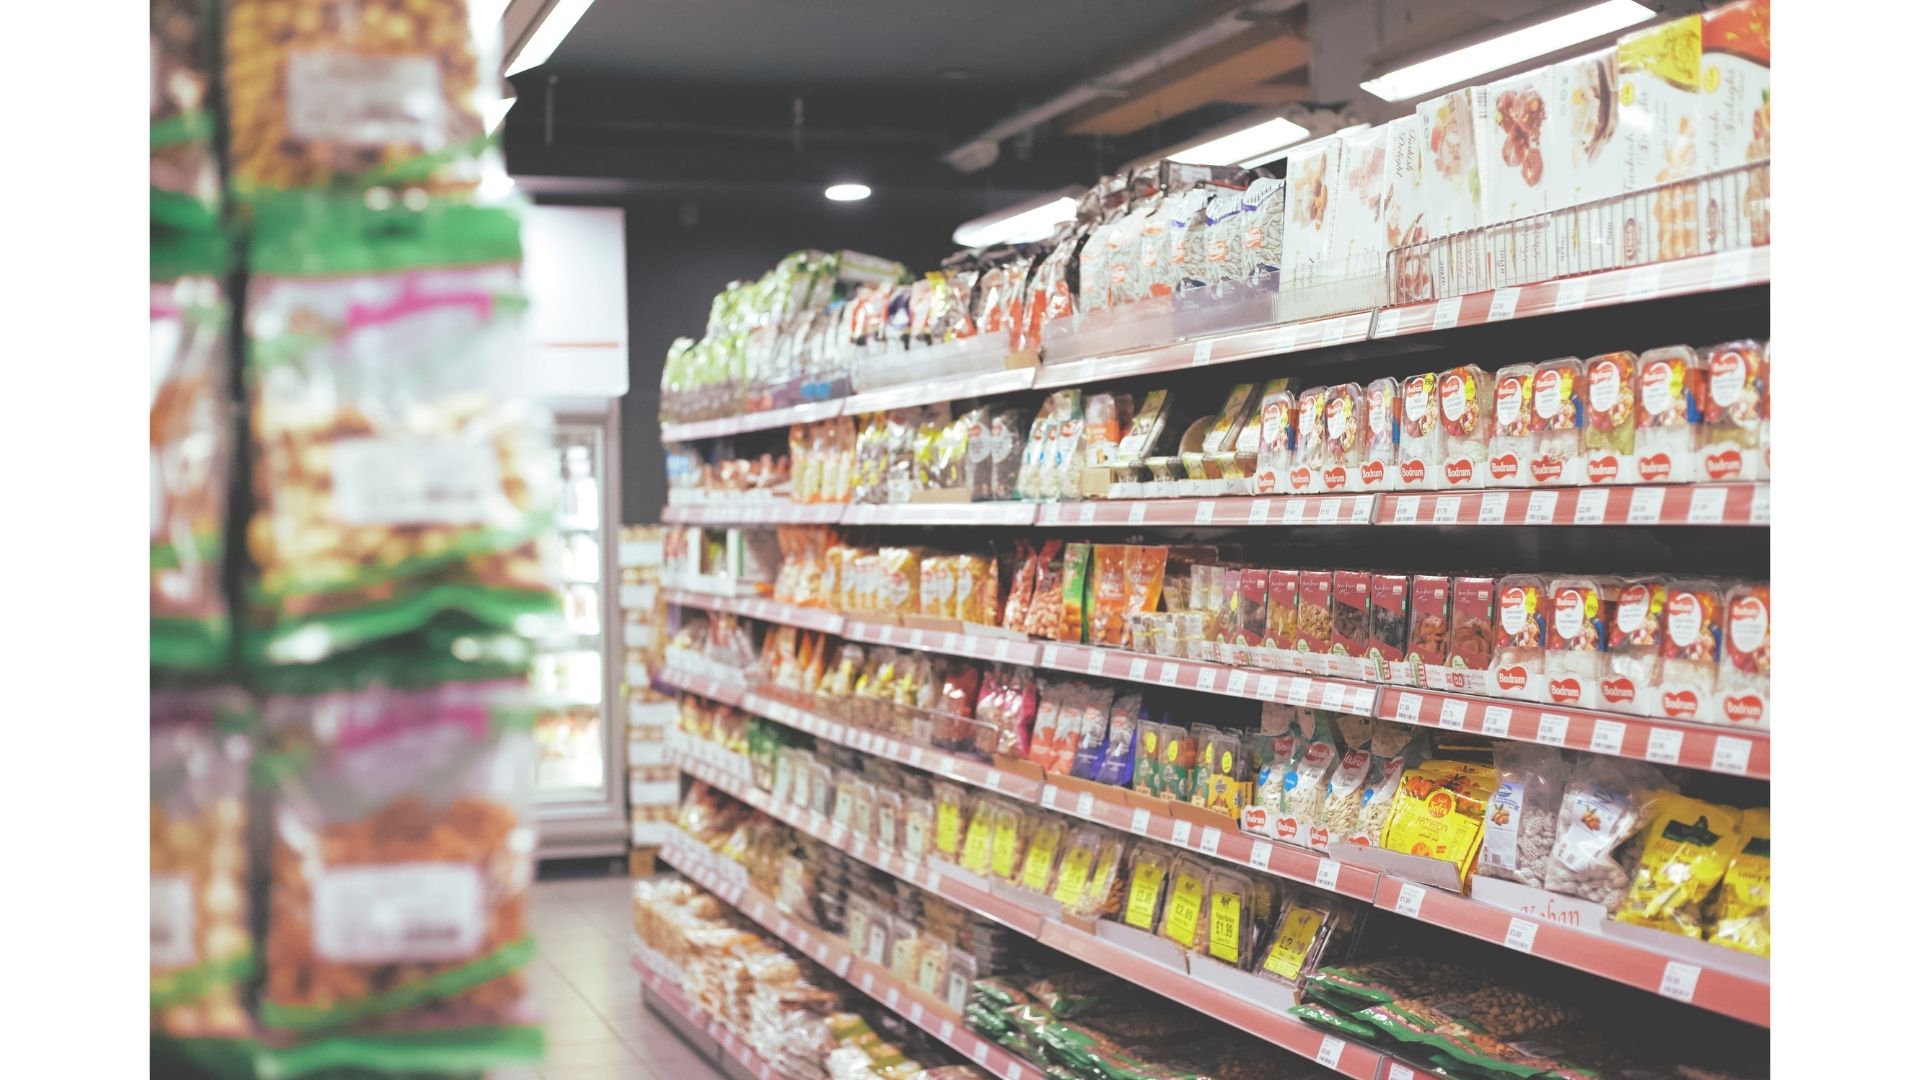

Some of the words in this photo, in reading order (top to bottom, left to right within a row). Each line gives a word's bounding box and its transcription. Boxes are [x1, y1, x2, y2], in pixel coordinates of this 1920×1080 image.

[1401, 468, 1424, 478] Bodrum
[1447, 468, 1471, 478] Bodrum
[1491, 462, 1518, 473] Bodrum
[1532, 464, 1561, 475] Bodrum
[1589, 465, 1617, 476] Bodrum
[1324, 472, 1345, 483] Bodrum
[1361, 468, 1383, 479] Bodrum
[1499, 673, 1526, 685] Bodrum
[1551, 686, 1579, 698] Bodrum
[1604, 686, 1633, 698] Bodrum
[1665, 699, 1696, 711] Bodrum
[1727, 703, 1761, 716] Bodrum
